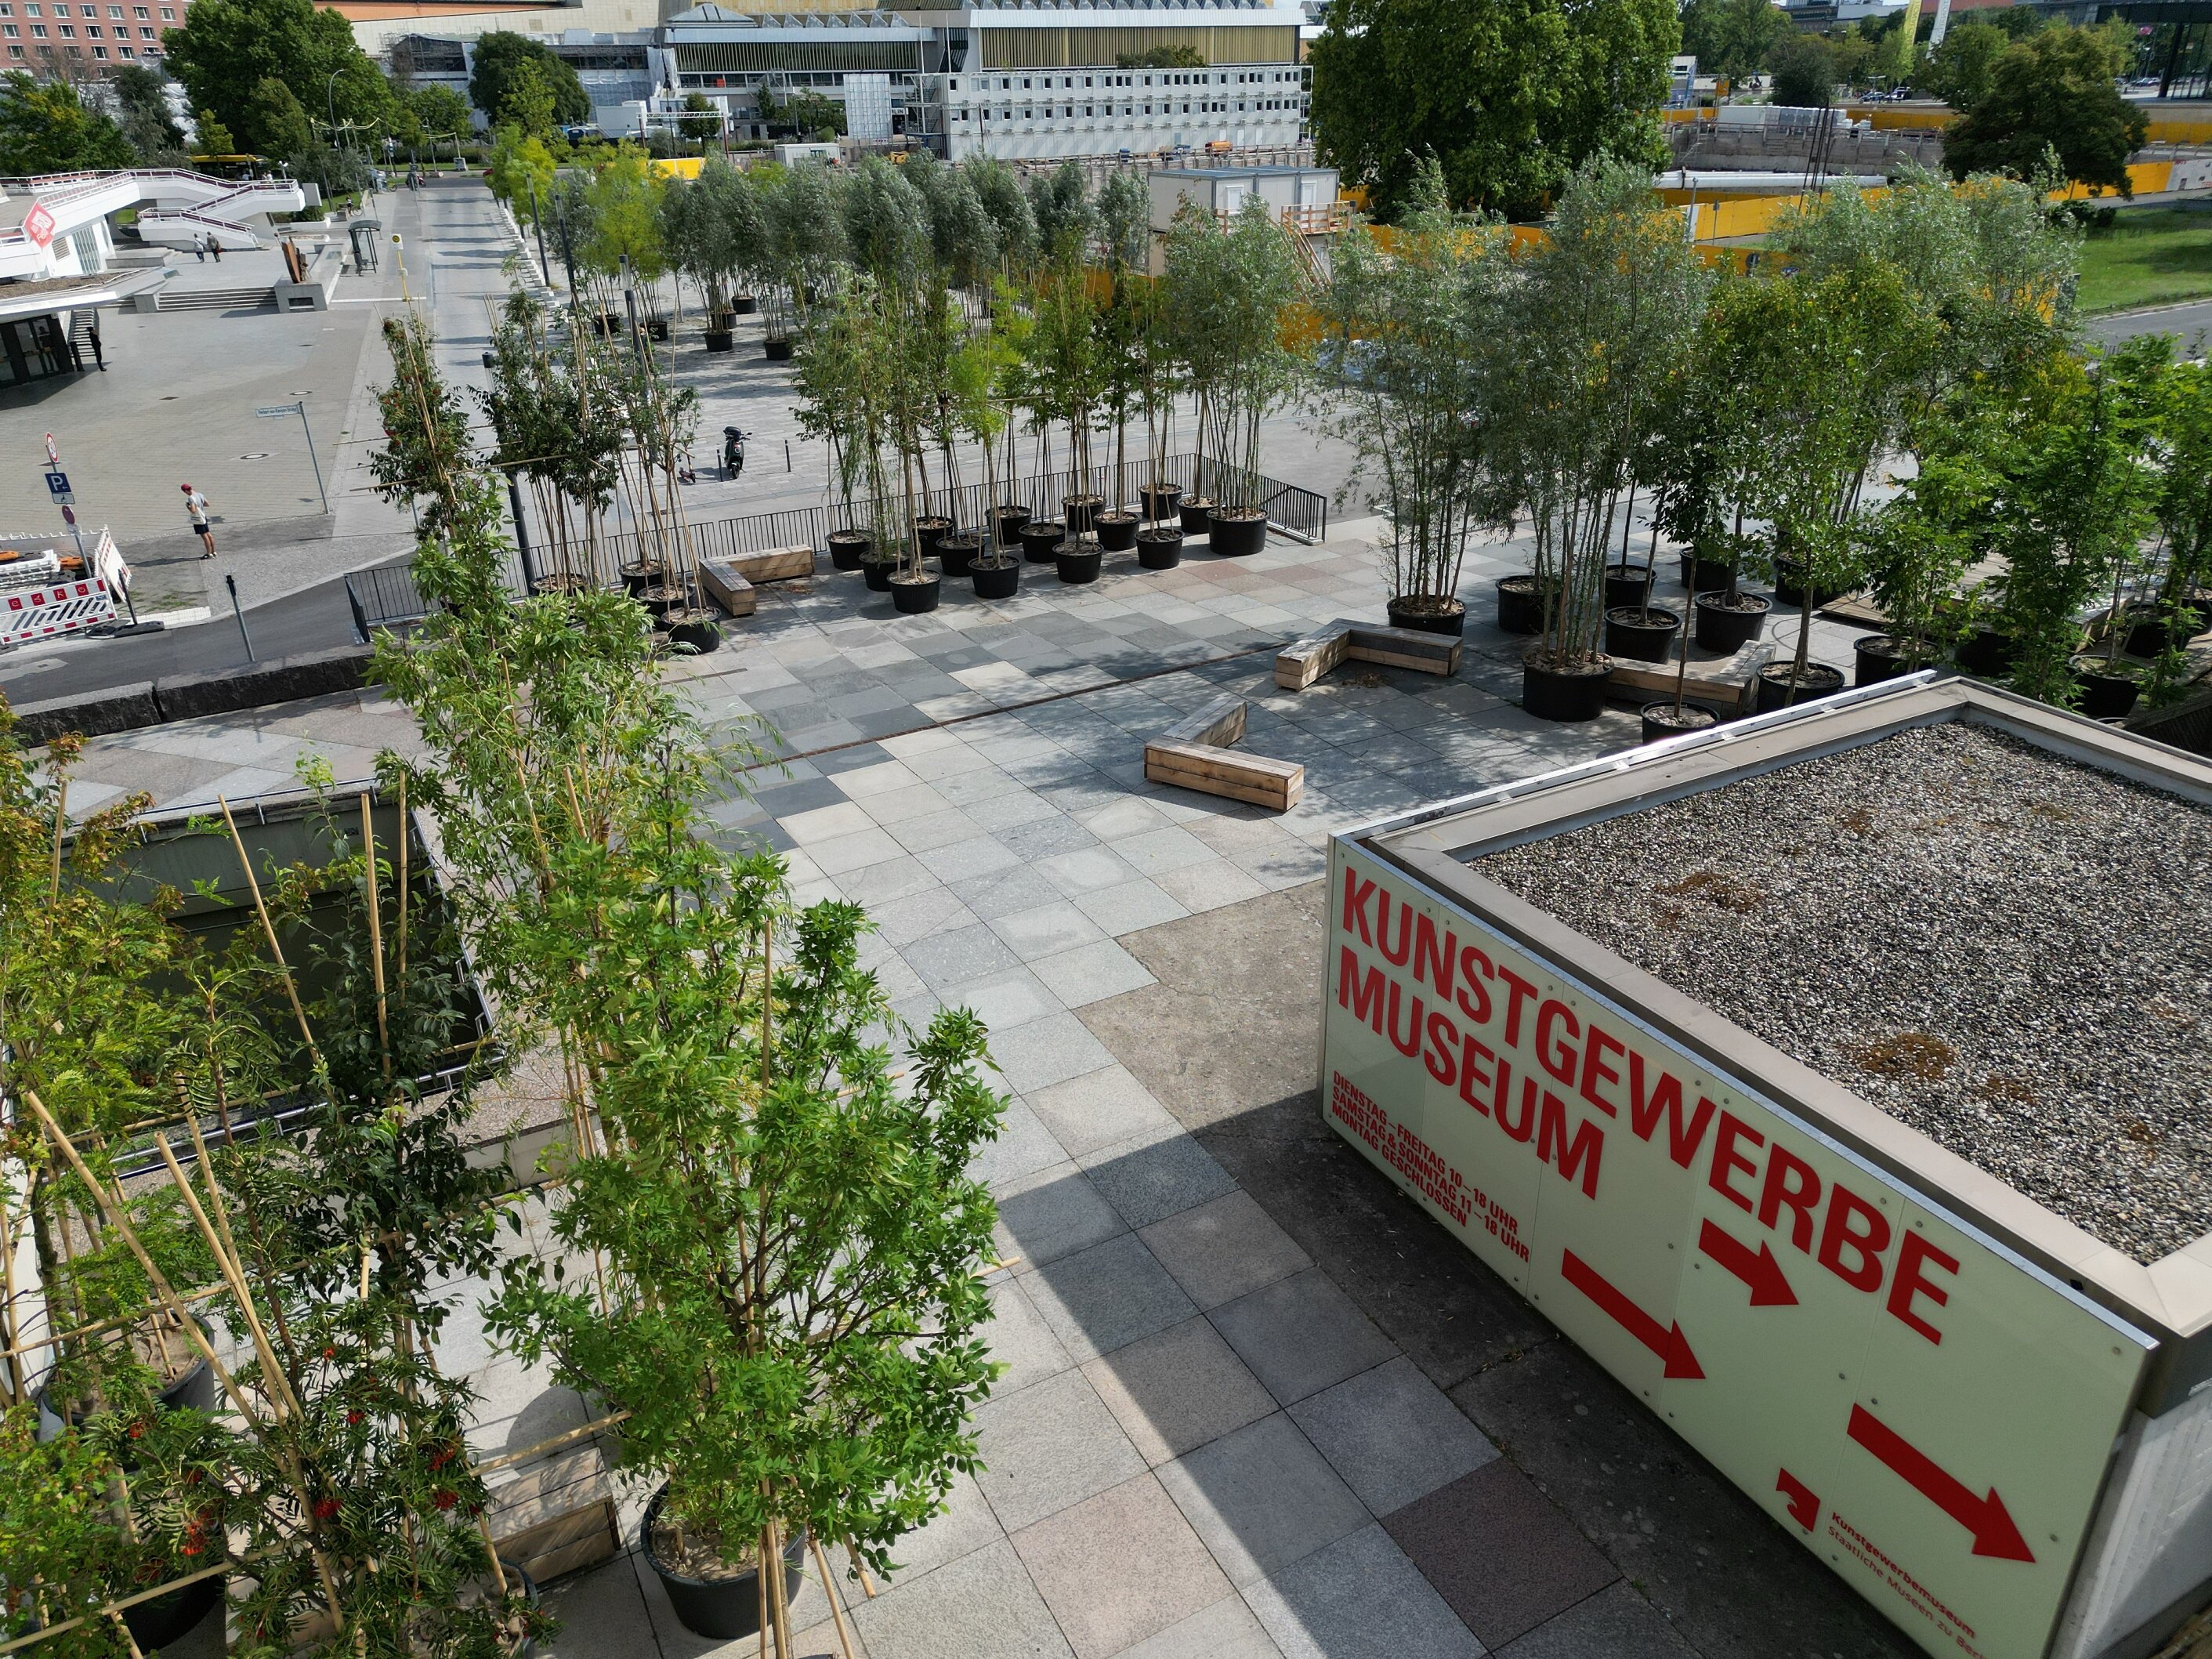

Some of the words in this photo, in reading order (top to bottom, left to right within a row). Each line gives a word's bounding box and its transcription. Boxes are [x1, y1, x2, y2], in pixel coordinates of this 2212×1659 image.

[50, 475, 63, 491] P
[1338, 945, 1605, 1200] MUSEUM
[1342, 865, 1960, 1346] KUNSTGEWERBE
[1332, 1100, 1378, 1150] MONTAG
[1382, 1144, 1467, 1226] GESCHLOSSEN
[1333, 1086, 1391, 1140] SAMSTAG
[1388, 1136, 1396, 1149] &
[1399, 1143, 1457, 1201] SONNTAG
[1501, 1228, 1529, 1262] UHR
[1490, 1201, 1518, 1236] UHR
[1828, 1526, 1883, 1578] Staatliche
[1888, 1576, 1934, 1621] Museen
[1936, 1620, 1952, 1637] zu
[1832, 1512, 1975, 1639] Kunstgewerbemuseum
